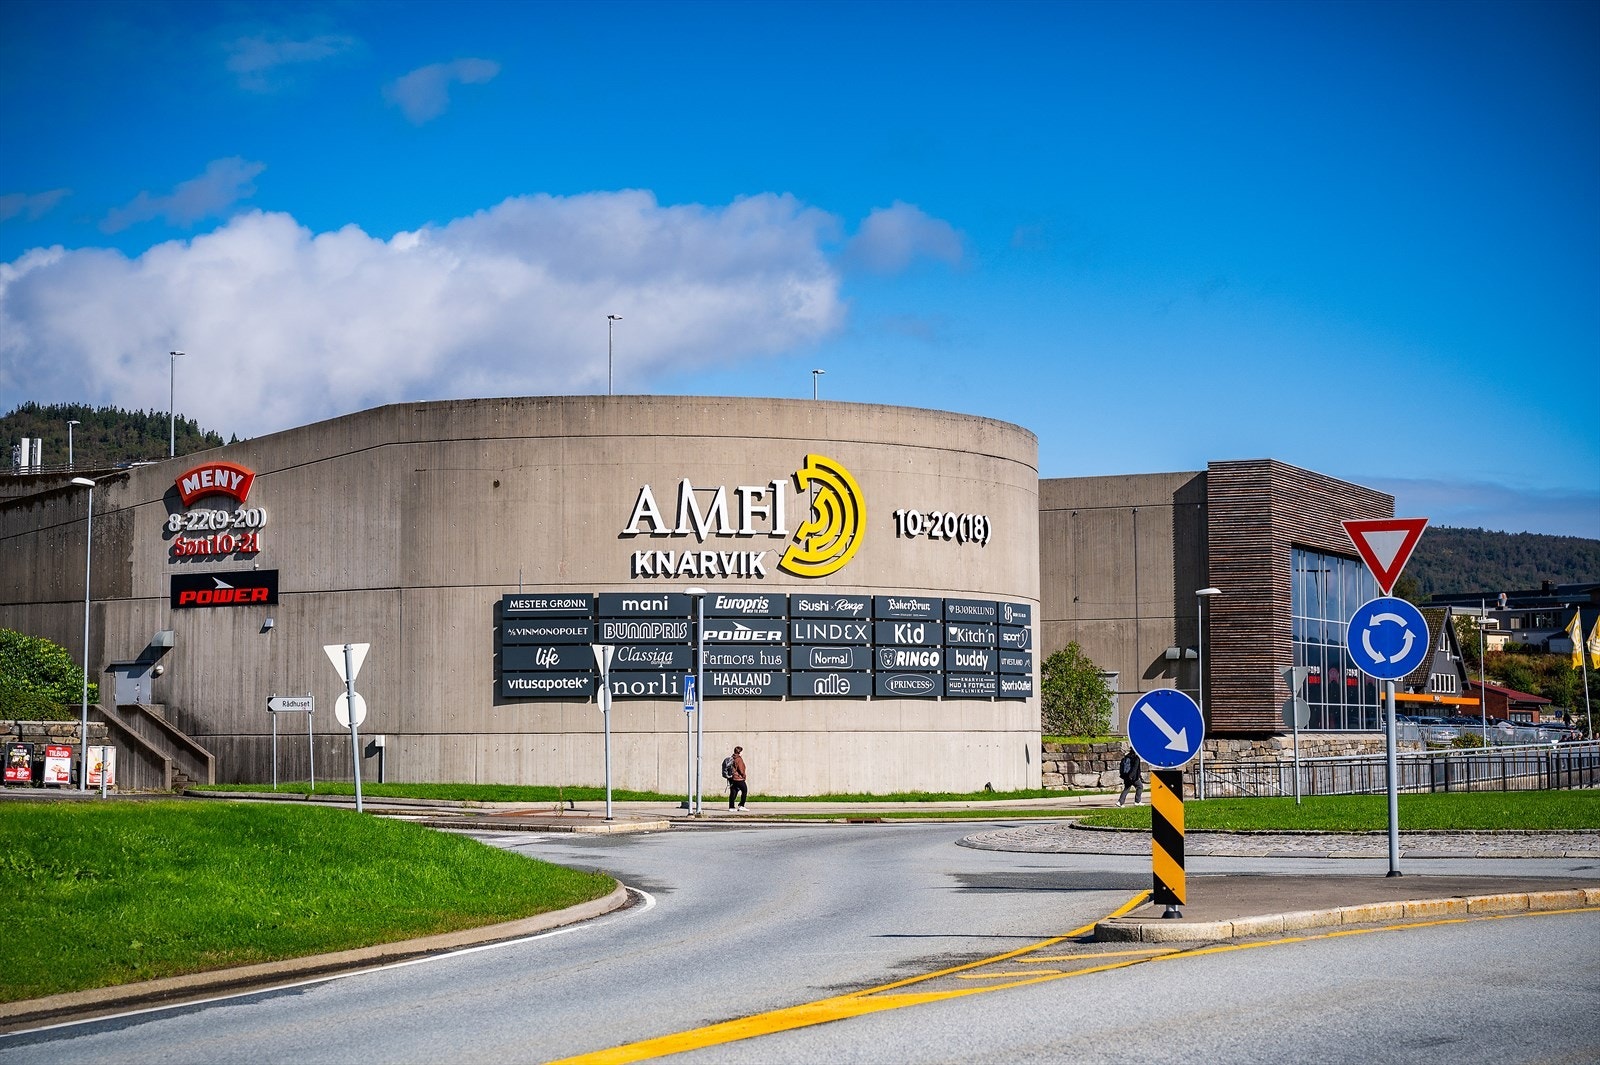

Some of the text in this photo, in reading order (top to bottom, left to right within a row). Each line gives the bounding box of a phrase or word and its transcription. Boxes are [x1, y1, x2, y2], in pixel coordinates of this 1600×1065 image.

[182, 469, 244, 495] MENY
[622, 478, 789, 540] AMFI
[896, 509, 992, 544] 10-20(18)
[634, 550, 767, 575] KNARVIK
[179, 587, 269, 605] POWER
[509, 599, 586, 608] MESTER GRØNN
[622, 595, 669, 611] mani
[715, 595, 769, 613] Europris
[798, 600, 829, 611] iSushi
[955, 605, 995, 616] BJØRKLUND
[516, 627, 589, 636] VINMONOPOLET
[603, 622, 688, 639] BUNNPRIS
[703, 630, 782, 641] POWER
[795, 623, 867, 640] LINDEX
[894, 622, 925, 644] Kid
[535, 647, 560, 669] life
[703, 650, 782, 665] Farmors hus
[814, 651, 848, 664] Normal
[896, 651, 940, 667] RINGO
[955, 650, 988, 671] buddy
[612, 673, 679, 695] norli
[713, 673, 772, 686] HAALAND
[814, 673, 850, 695] nille
[894, 681, 930, 689] PRINCESS
[722, 687, 762, 695] EUROSKO
[282, 700, 310, 708] Rådhuset
[49, 749, 69, 757] TILBUD
